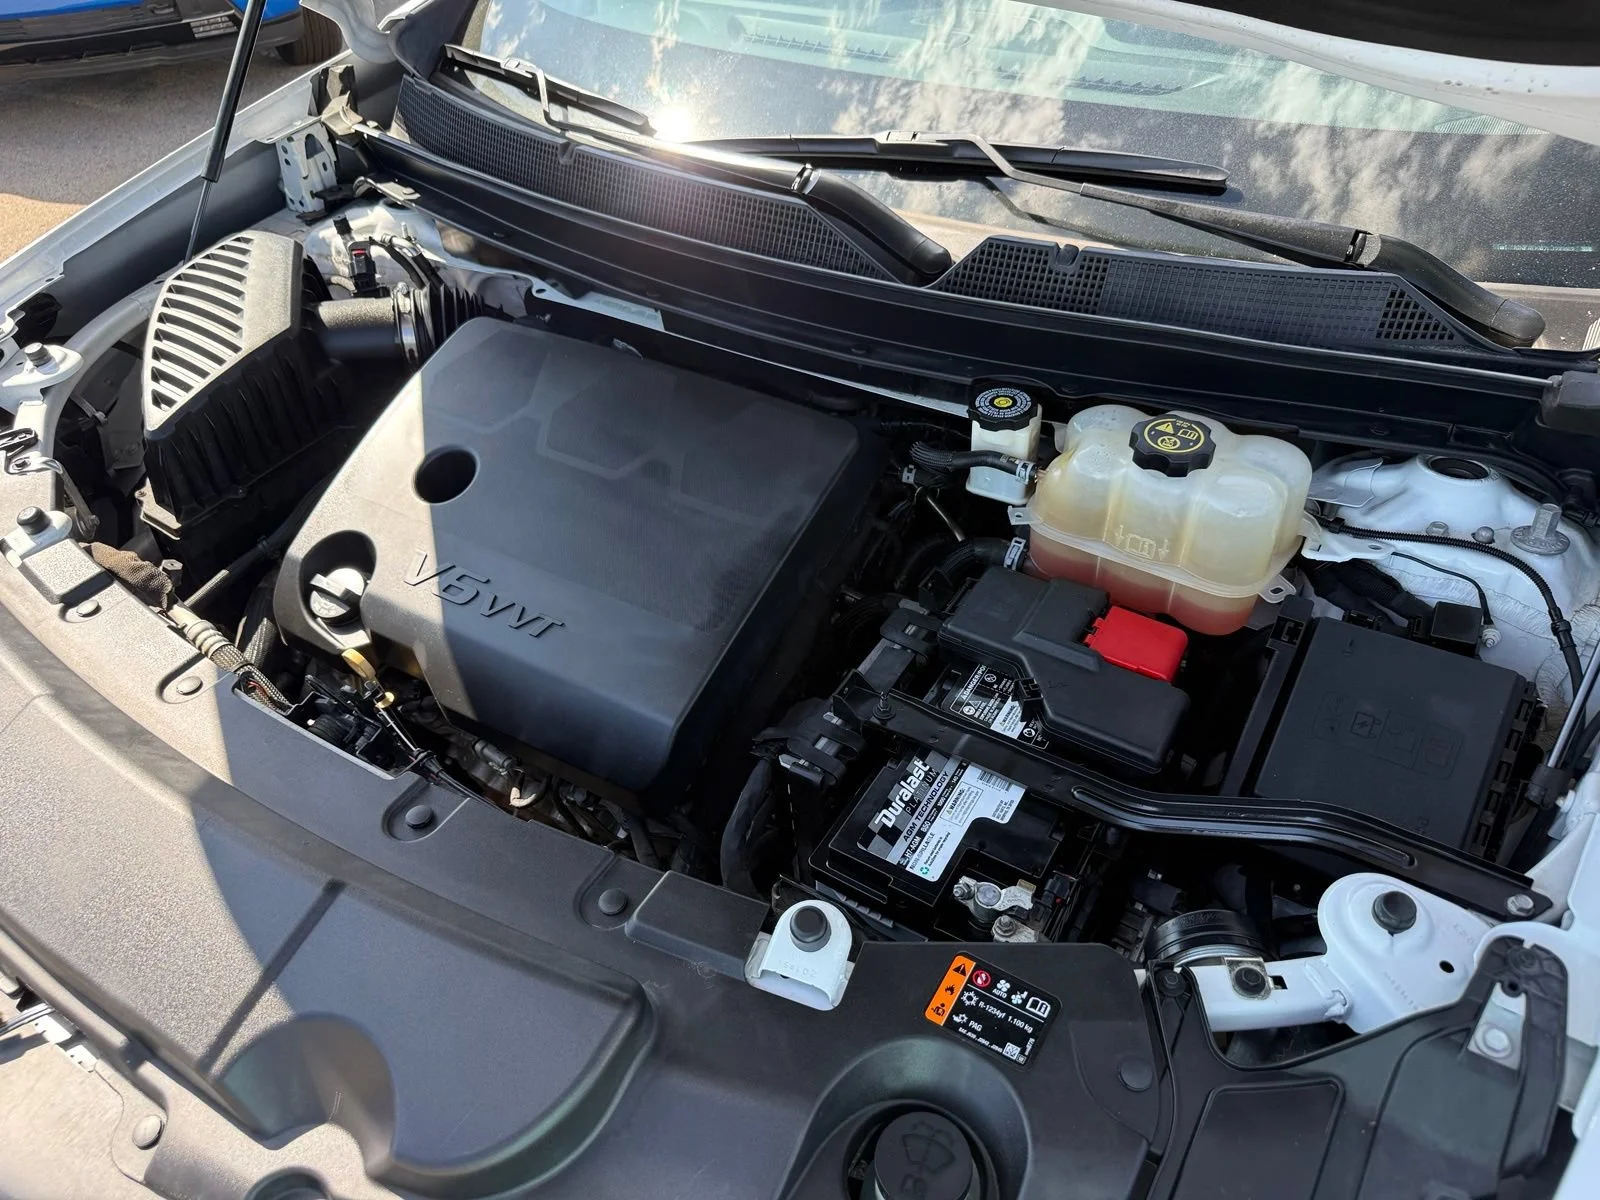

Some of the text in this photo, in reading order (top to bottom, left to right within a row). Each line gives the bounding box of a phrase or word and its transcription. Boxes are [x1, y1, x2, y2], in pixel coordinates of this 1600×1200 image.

[874, 758, 930, 829] Duralast
[903, 822, 918, 842] AGM
[915, 771, 949, 820] TECHNOLOGY
[905, 768, 938, 814] PLATINUM
[992, 988, 1007, 999] AUTO
[968, 1020, 983, 1032] PAG
[978, 1001, 1006, 1019] R-1234yf
